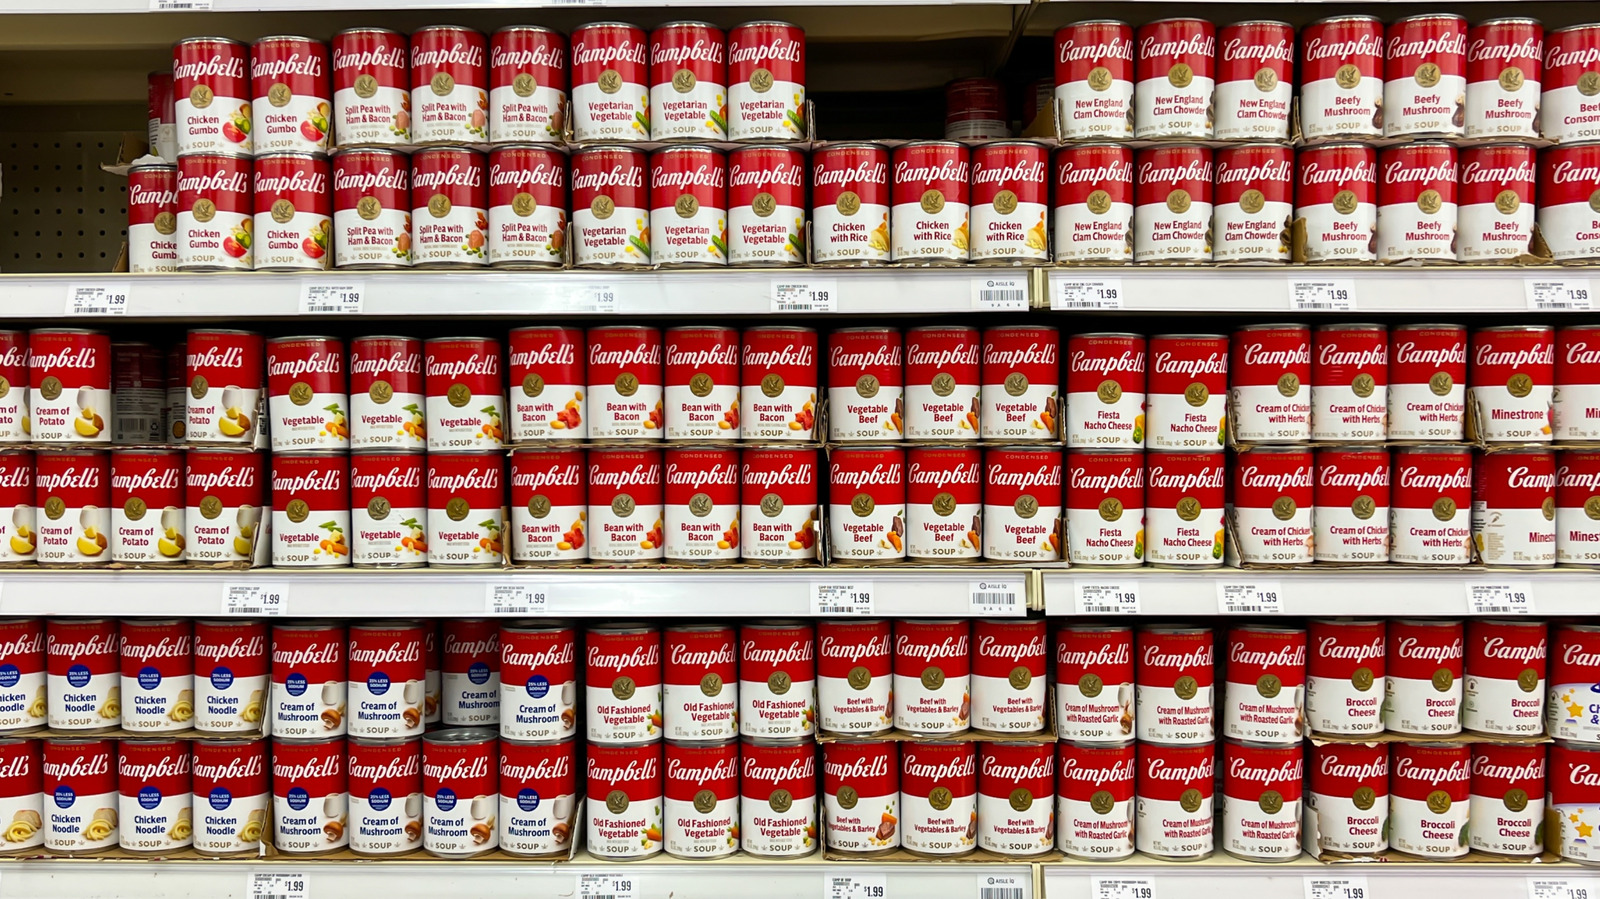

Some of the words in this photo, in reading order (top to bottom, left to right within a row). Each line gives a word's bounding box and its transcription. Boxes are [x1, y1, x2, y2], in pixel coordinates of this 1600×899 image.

[1387, 32, 1466, 58] Campbell's
[1156, 97, 1173, 105] New
[1174, 95, 1203, 106] England
[1414, 94, 1440, 104] Beefy
[1153, 107, 1172, 116] Clam
[1174, 106, 1204, 114] Chowder
[1403, 106, 1450, 116] Mushroom
[265, 114, 297, 123] Chicken
[267, 125, 296, 134] Gumbo
[334, 164, 407, 191] Campbell's
[729, 161, 801, 189] Campbell's
[814, 161, 886, 187] Campbell's
[1216, 160, 1290, 185] Campbell's
[178, 170, 247, 194] Campbell's
[347, 227, 362, 236] Split
[363, 226, 376, 235] Pea
[378, 228, 393, 236] with
[742, 225, 786, 234] Vegetarian
[833, 223, 865, 232] Chicken
[1227, 222, 1244, 230] New
[1245, 221, 1276, 232] England
[188, 230, 220, 238] Chicken
[830, 234, 848, 242] with
[850, 233, 868, 241] Rice
[1225, 233, 1243, 241] Clam
[1244, 231, 1278, 240] Chowder
[190, 240, 219, 248] Gumbo
[364, 236, 370, 244] &
[371, 236, 393, 245] Bacon
[744, 234, 784, 245] Vegetable
[340, 293, 359, 302] $1.99
[595, 293, 613, 302] $1.99
[809, 292, 828, 301] $1.99
[1097, 289, 1117, 298] $1.99
[1328, 290, 1347, 300] $1.99
[1567, 290, 1587, 299] $1.99
[107, 295, 125, 304] $1.99
[267, 352, 340, 378] Campbell's
[36, 407, 59, 415] Cream
[1492, 409, 1543, 419] Minestrone
[40, 417, 65, 425] Potato
[282, 416, 324, 426] Vegetable
[666, 463, 737, 488] Campbell's
[989, 464, 1061, 490] Campbell's
[1150, 466, 1224, 492] Campbell's
[194, 526, 218, 534] Cream
[681, 523, 701, 533] Bean
[1005, 525, 1046, 535] Vegetable
[1178, 528, 1199, 536] Fiesta
[1410, 527, 1436, 536] Cream
[1438, 528, 1446, 536] of
[198, 536, 224, 544] Potato
[688, 533, 713, 541] Bacon
[1017, 534, 1036, 544] Beef
[1164, 538, 1186, 546] Nacho
[261, 594, 279, 604] $1.99
[526, 594, 544, 603] $1.99
[851, 593, 869, 603] $1.99
[1116, 593, 1135, 603] $1.99
[1257, 592, 1276, 602] $1.99
[1505, 593, 1525, 602] $1.99
[195, 637, 263, 662] Campbell's
[896, 635, 968, 662] Campbell's
[502, 643, 573, 670] Campbell's
[1057, 644, 1129, 669] Campbell's
[207, 696, 238, 704] Chicken
[208, 706, 237, 714] Noodle
[520, 705, 546, 713] Cream
[548, 704, 556, 712] of
[906, 705, 937, 713] Vegetables
[1065, 703, 1081, 712] Cream
[1082, 704, 1087, 712] of
[1088, 704, 1119, 712] Mushroom
[516, 715, 559, 723] Mushroom
[1067, 714, 1077, 722] with
[1078, 714, 1102, 723] Roasted
[1102, 714, 1118, 723] Garlic
[744, 756, 814, 784] Campbell's
[754, 818, 766, 826] Old
[768, 816, 806, 827] Fashioned
[1421, 820, 1455, 829] Broccoli
[1498, 818, 1531, 827] Broccoli
[136, 826, 165, 834] Noodle
[760, 826, 800, 838] Vegetable
[1423, 830, 1453, 839] Cheese
[1499, 828, 1530, 837] Cheese
[285, 881, 303, 891] $1.99
[613, 881, 631, 891] $1.99
[864, 886, 883, 897] $1.99
[1132, 888, 1151, 898] $1.99
[1344, 888, 1363, 898] $1.99
[1567, 889, 1587, 899] $1.99
